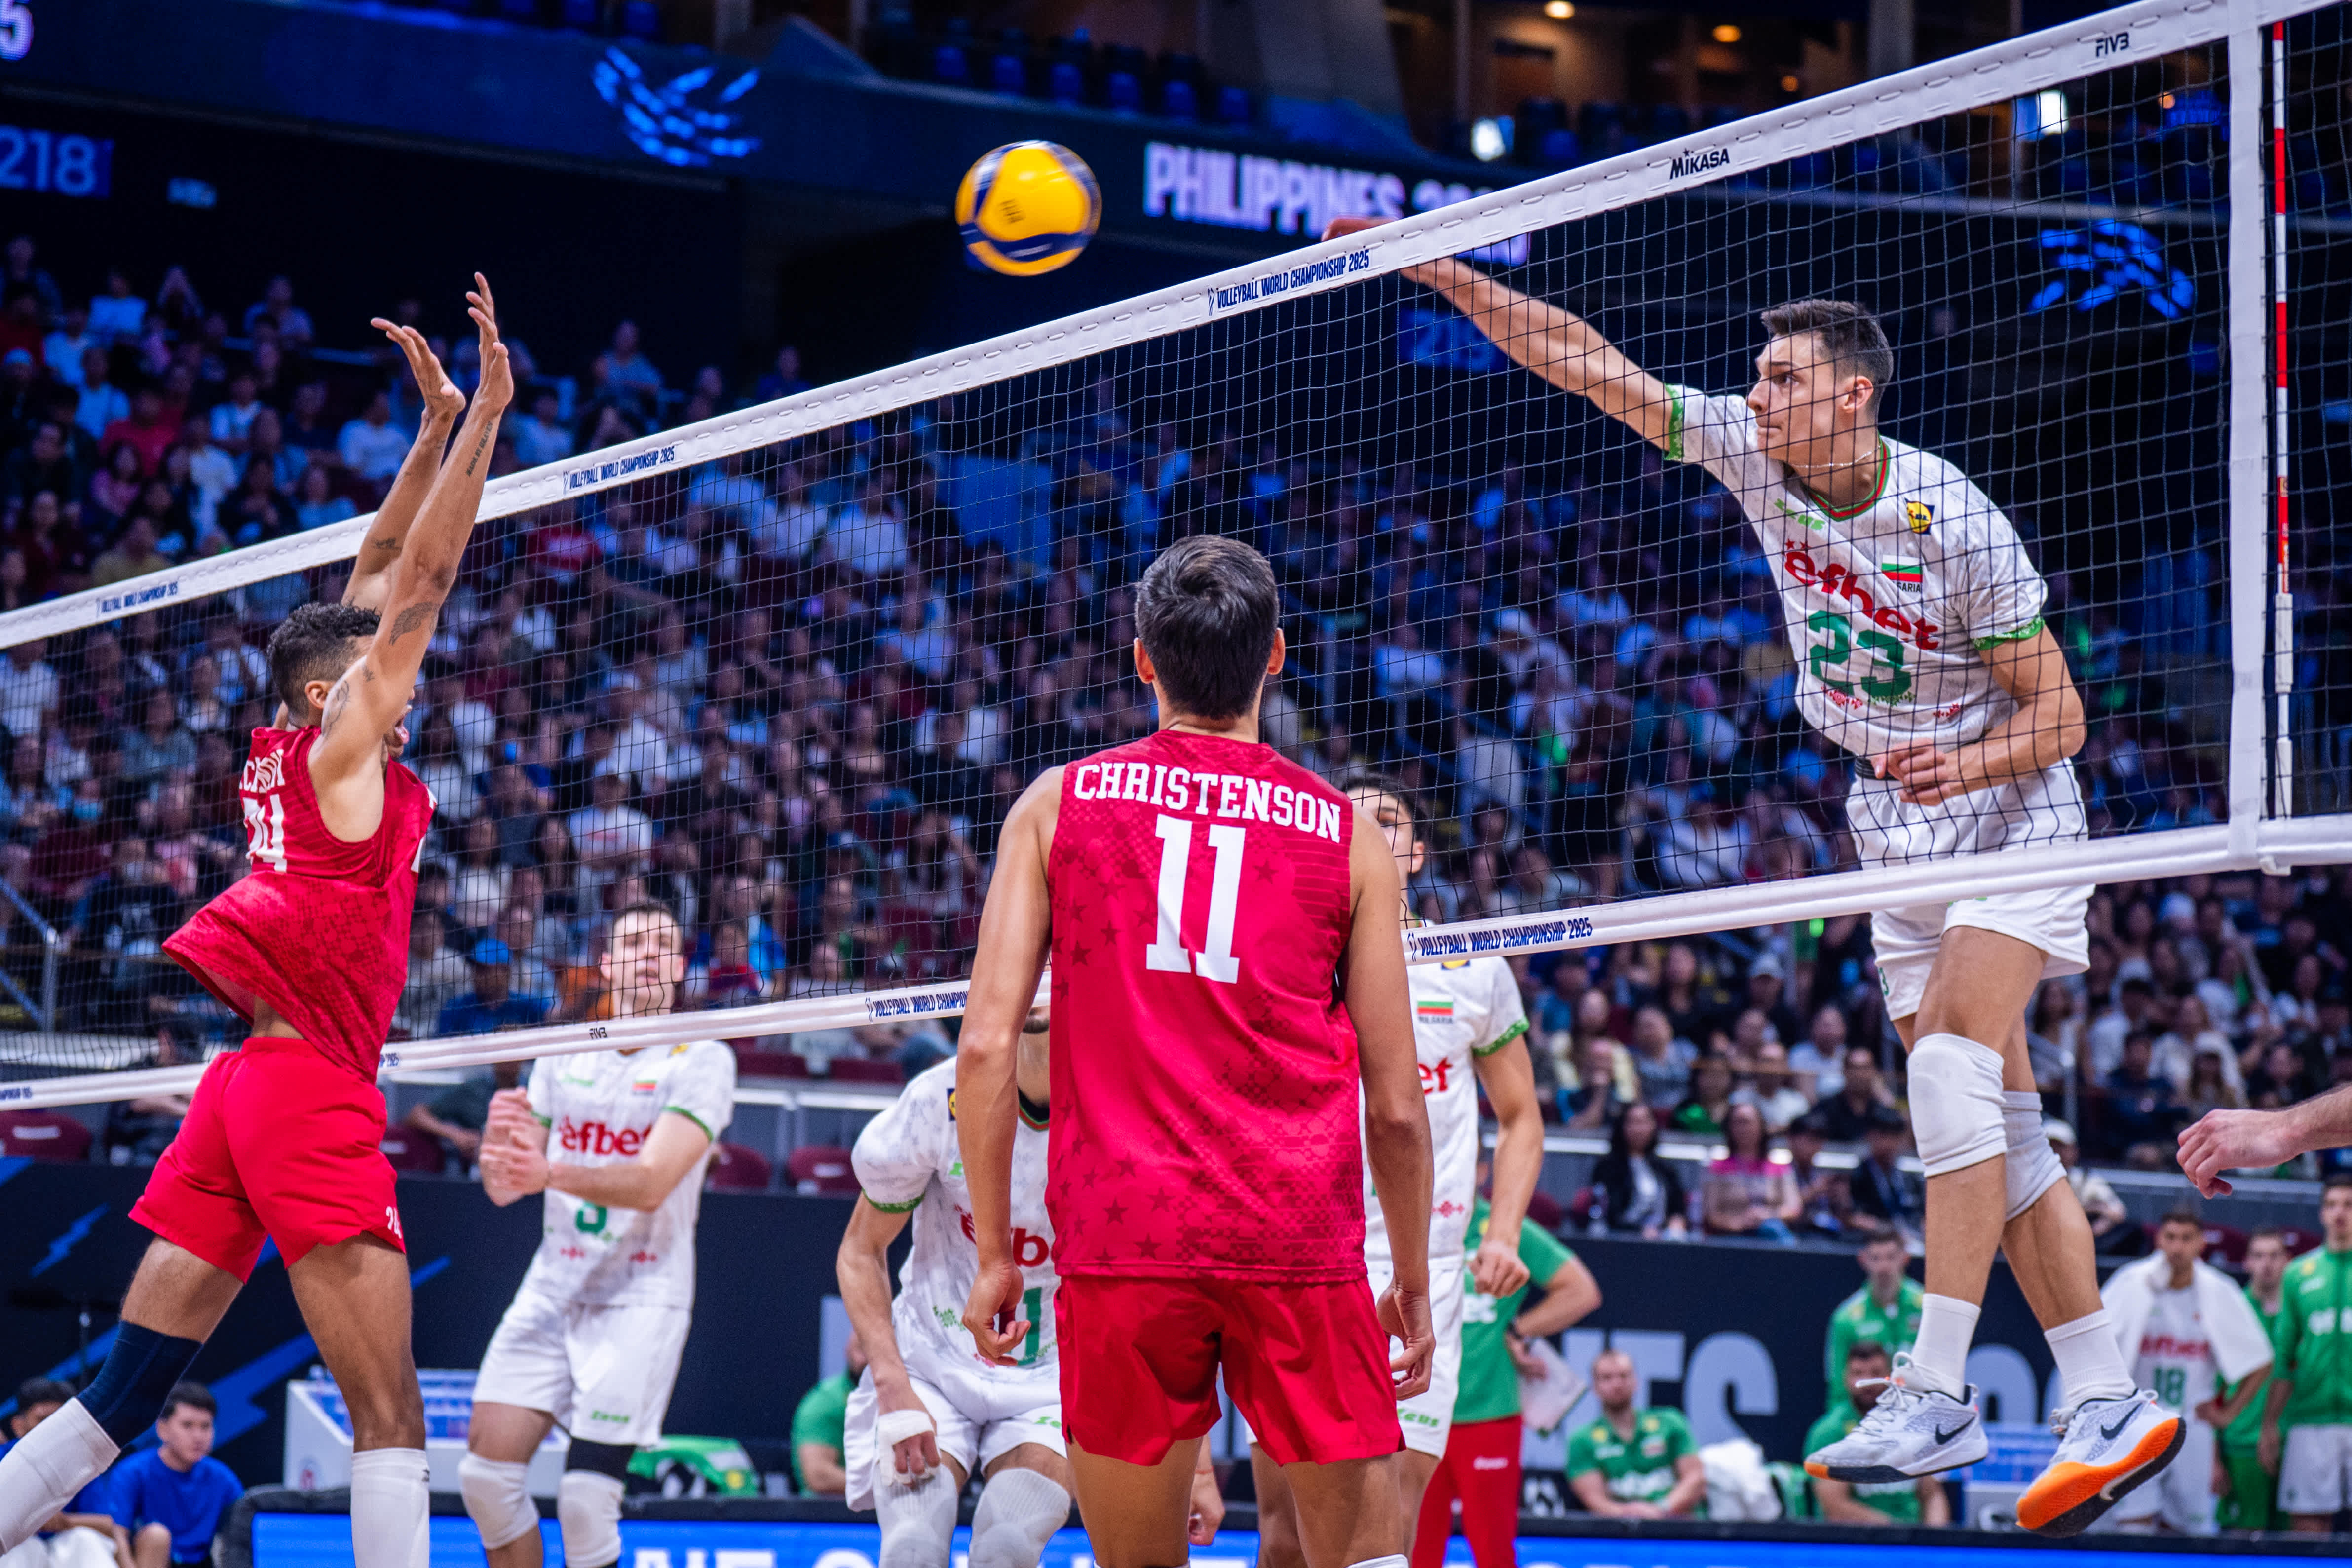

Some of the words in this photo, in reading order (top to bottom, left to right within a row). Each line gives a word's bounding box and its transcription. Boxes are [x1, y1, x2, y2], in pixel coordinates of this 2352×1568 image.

[1669, 148, 1730, 179] MIKASA
[1143, 141, 1404, 239] PHILIPPINES
[1217, 282, 1258, 308] VOLLEYBALL
[1261, 272, 1288, 296] WORLD
[1290, 256, 1346, 288] CHAMPIONSHIP
[569, 467, 598, 489] VOLLEYBALL
[600, 462, 619, 480] WORLD
[620, 450, 659, 474] CHAMPIONSHIP
[1892, 580, 1921, 593] GARIA
[1807, 609, 1912, 698] 23
[1074, 762, 1341, 844] CHRISTENSON
[1145, 813, 1246, 984] 11
[1418, 933, 1468, 956] VOLLEYBALL
[1468, 930, 1501, 952] WORLD
[1502, 921, 1566, 948] CHAMPIONSHIP
[873, 997, 910, 1017] VOLLEYBALL
[910, 994, 936, 1013] WORLD
